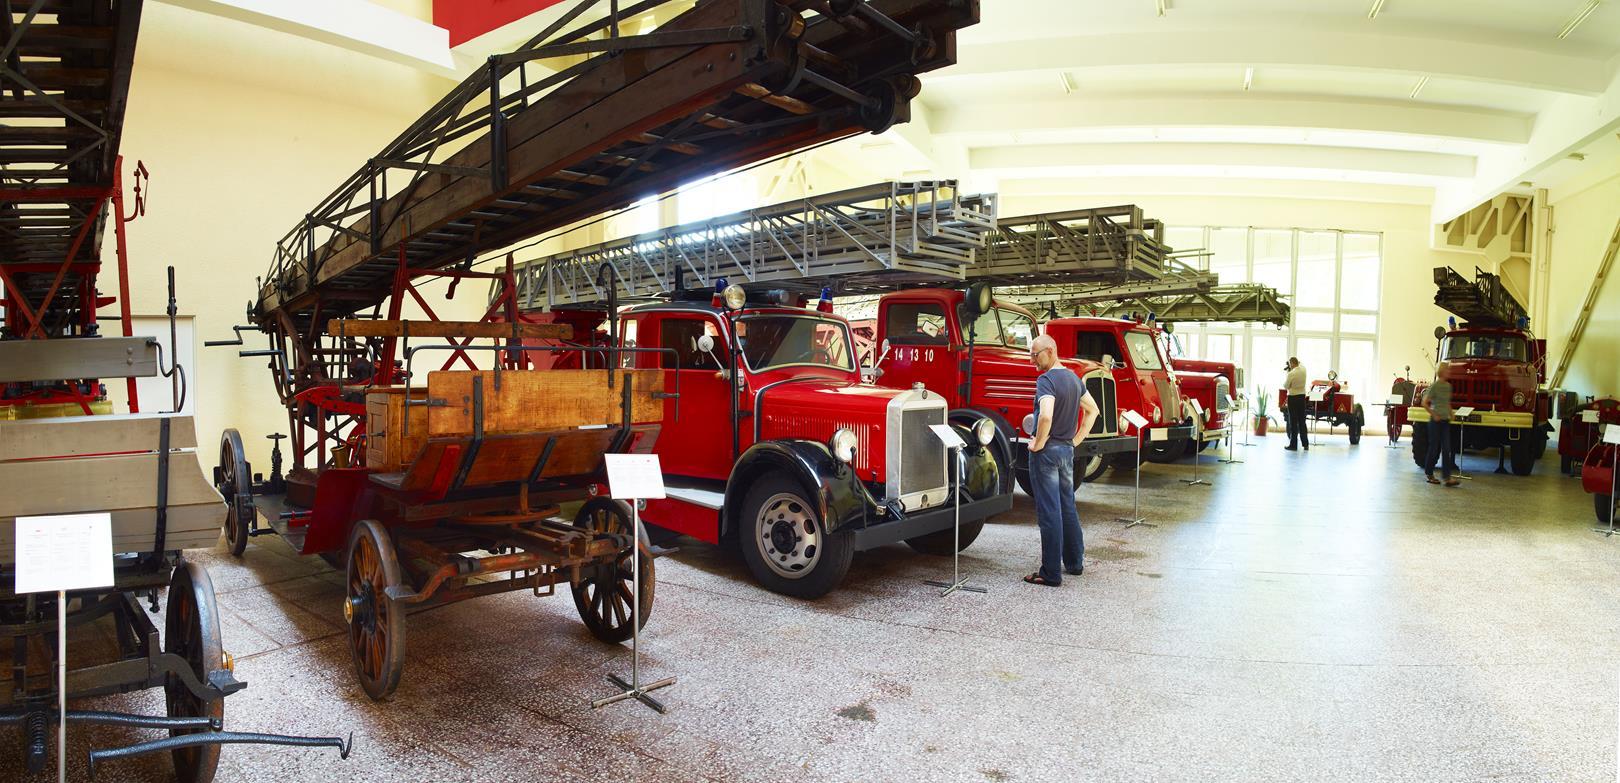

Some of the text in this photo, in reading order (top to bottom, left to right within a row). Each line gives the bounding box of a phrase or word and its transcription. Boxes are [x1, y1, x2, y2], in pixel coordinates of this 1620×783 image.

[895, 348, 934, 362] 14 13 10
